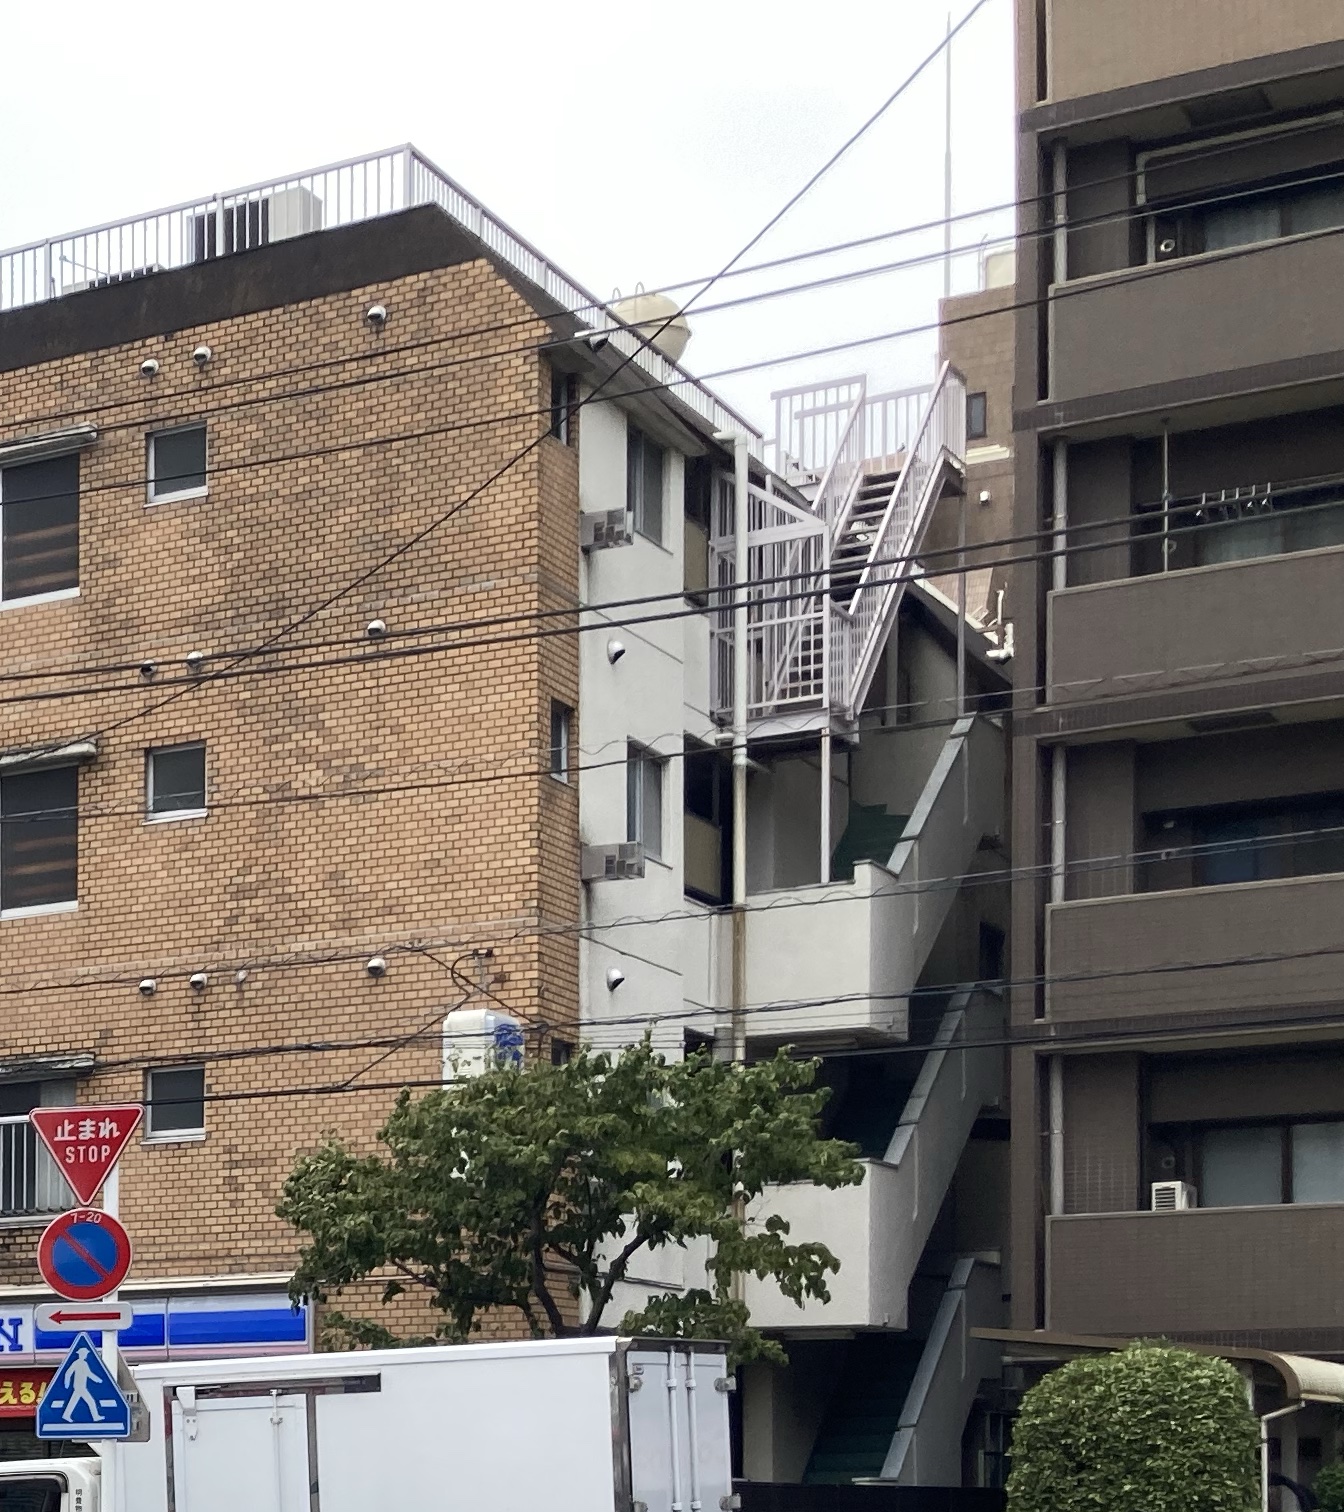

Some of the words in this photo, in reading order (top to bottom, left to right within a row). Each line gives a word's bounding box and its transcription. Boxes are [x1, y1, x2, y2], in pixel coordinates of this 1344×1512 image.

[54, 1117, 120, 1141] 止まれ
[65, 1145, 111, 1163] STOP
[70, 1212, 102, 1224] 7-20
